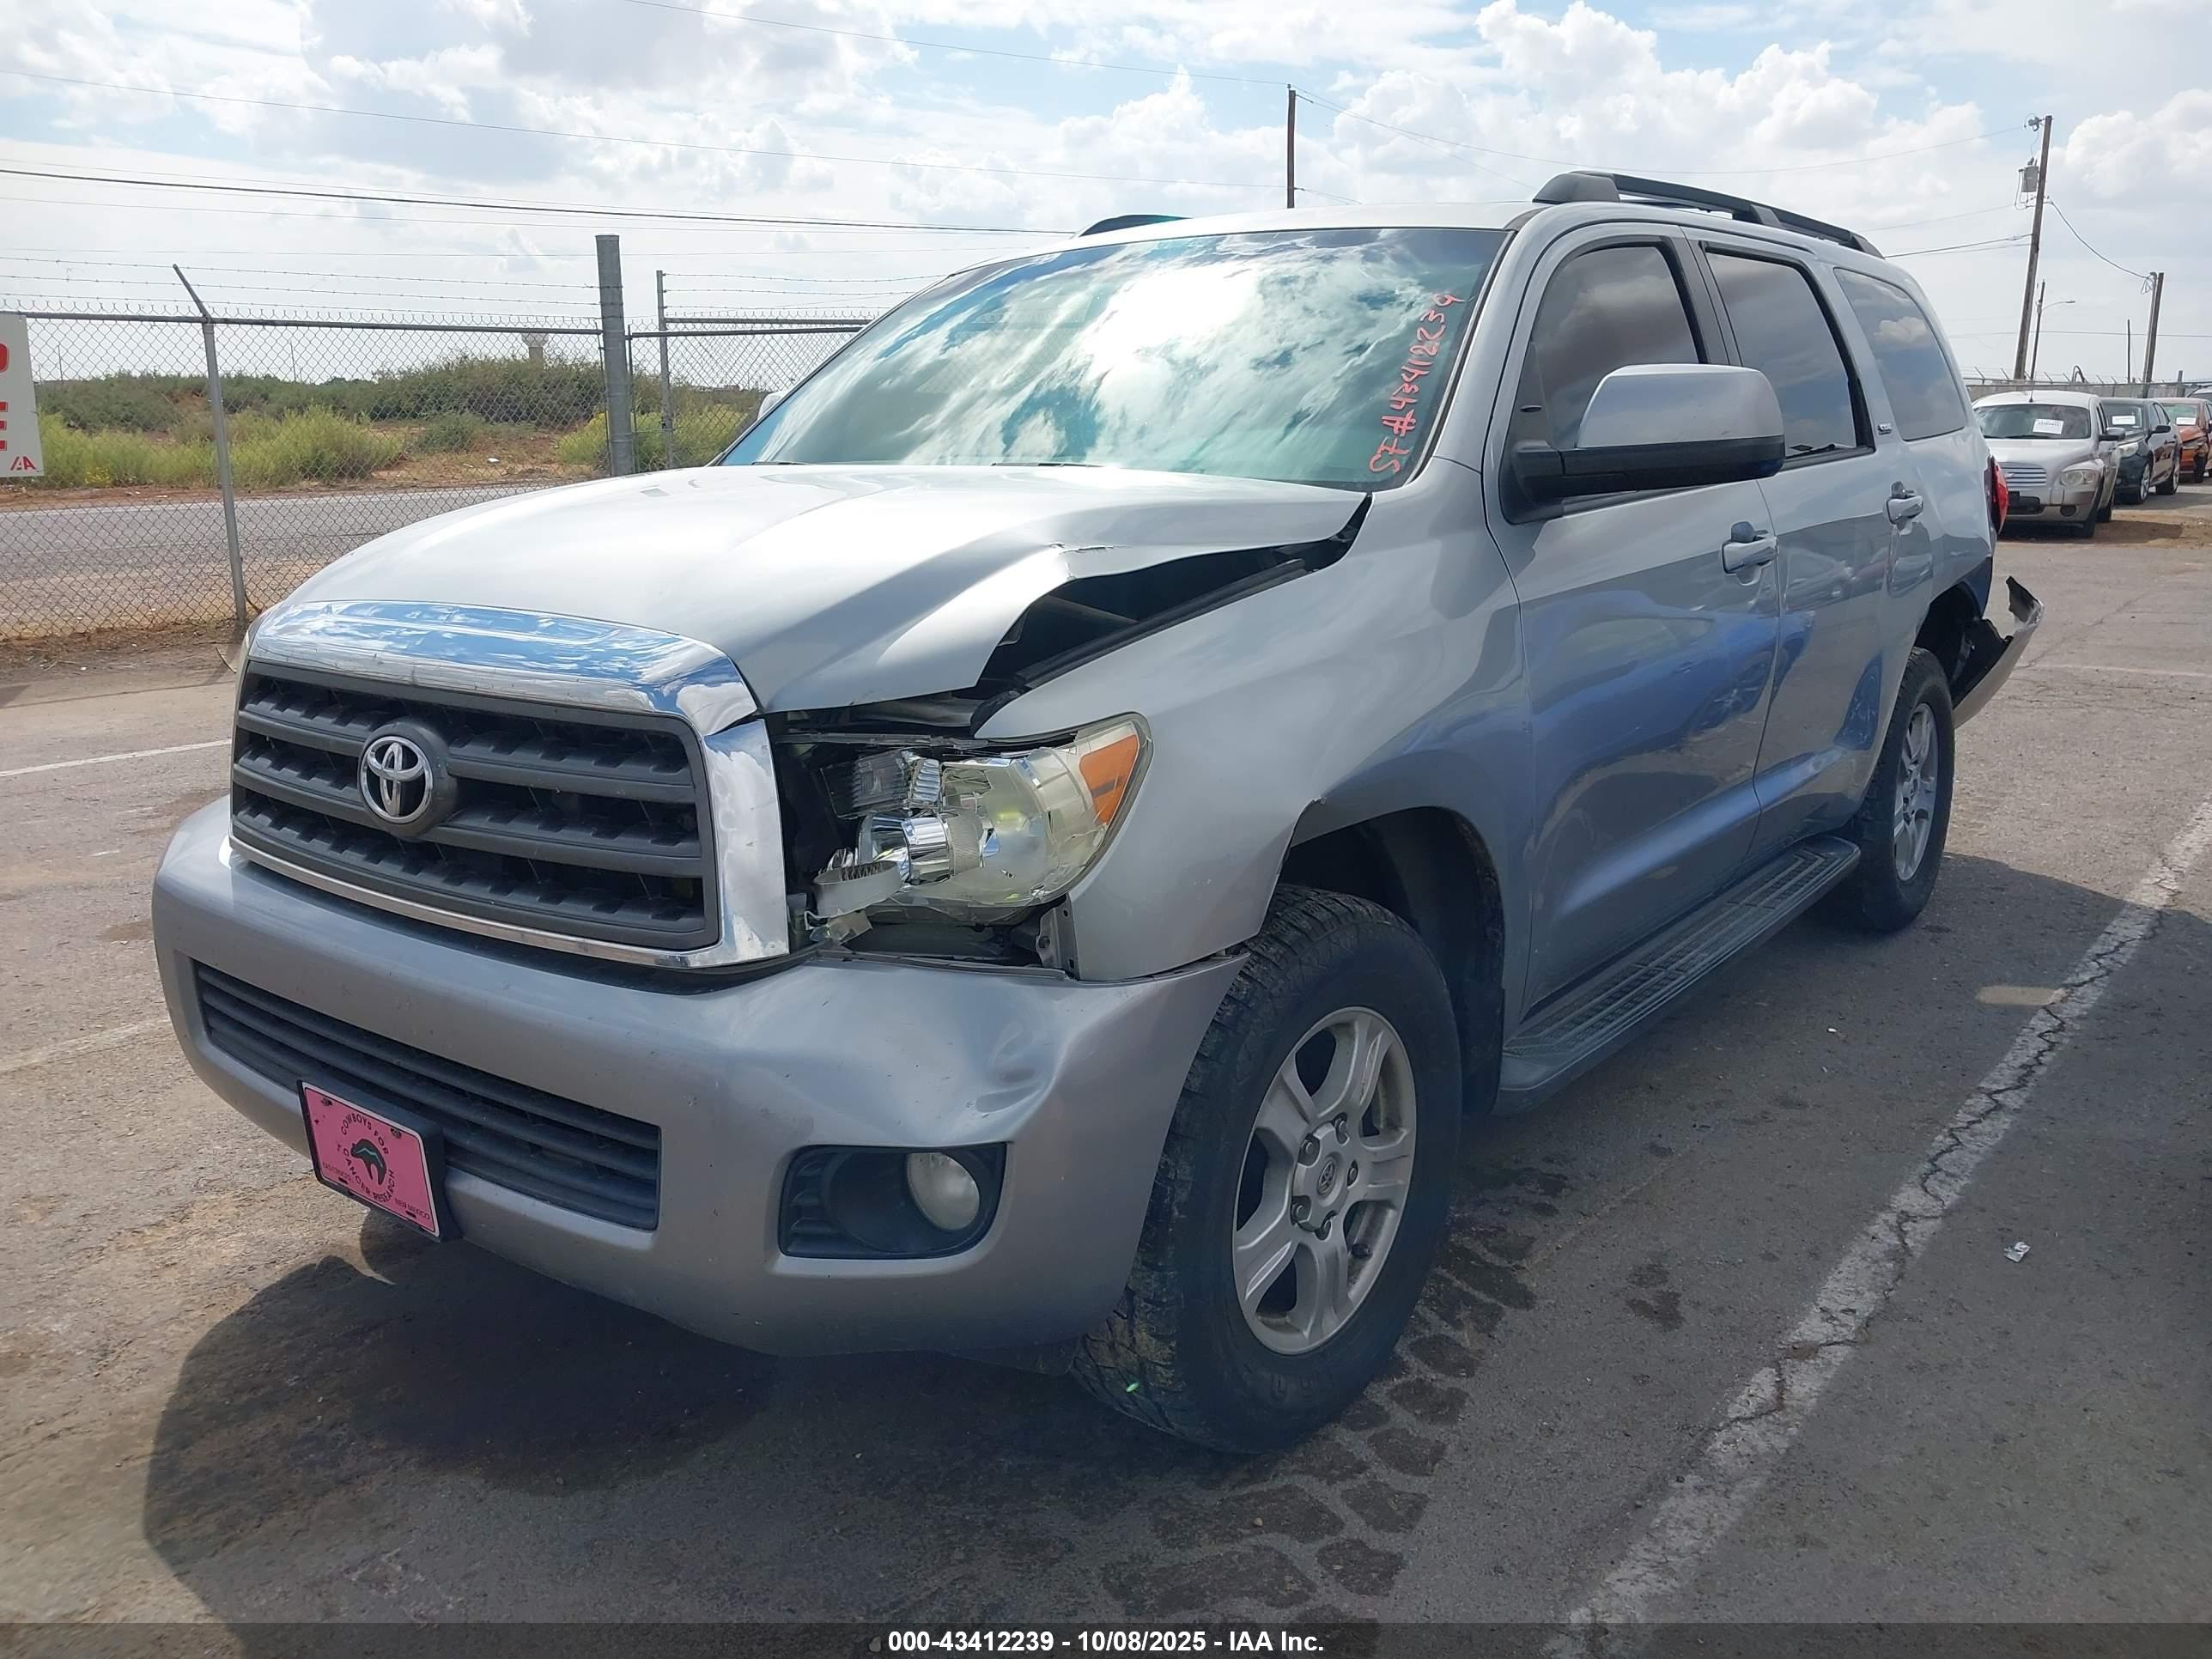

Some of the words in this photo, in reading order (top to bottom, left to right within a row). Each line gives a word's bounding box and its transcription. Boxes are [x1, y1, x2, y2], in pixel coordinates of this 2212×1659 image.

[340, 1110, 373, 1135] COWBOYS
[373, 1131, 390, 1155] FOR
[343, 1146, 371, 1194] CANCER
